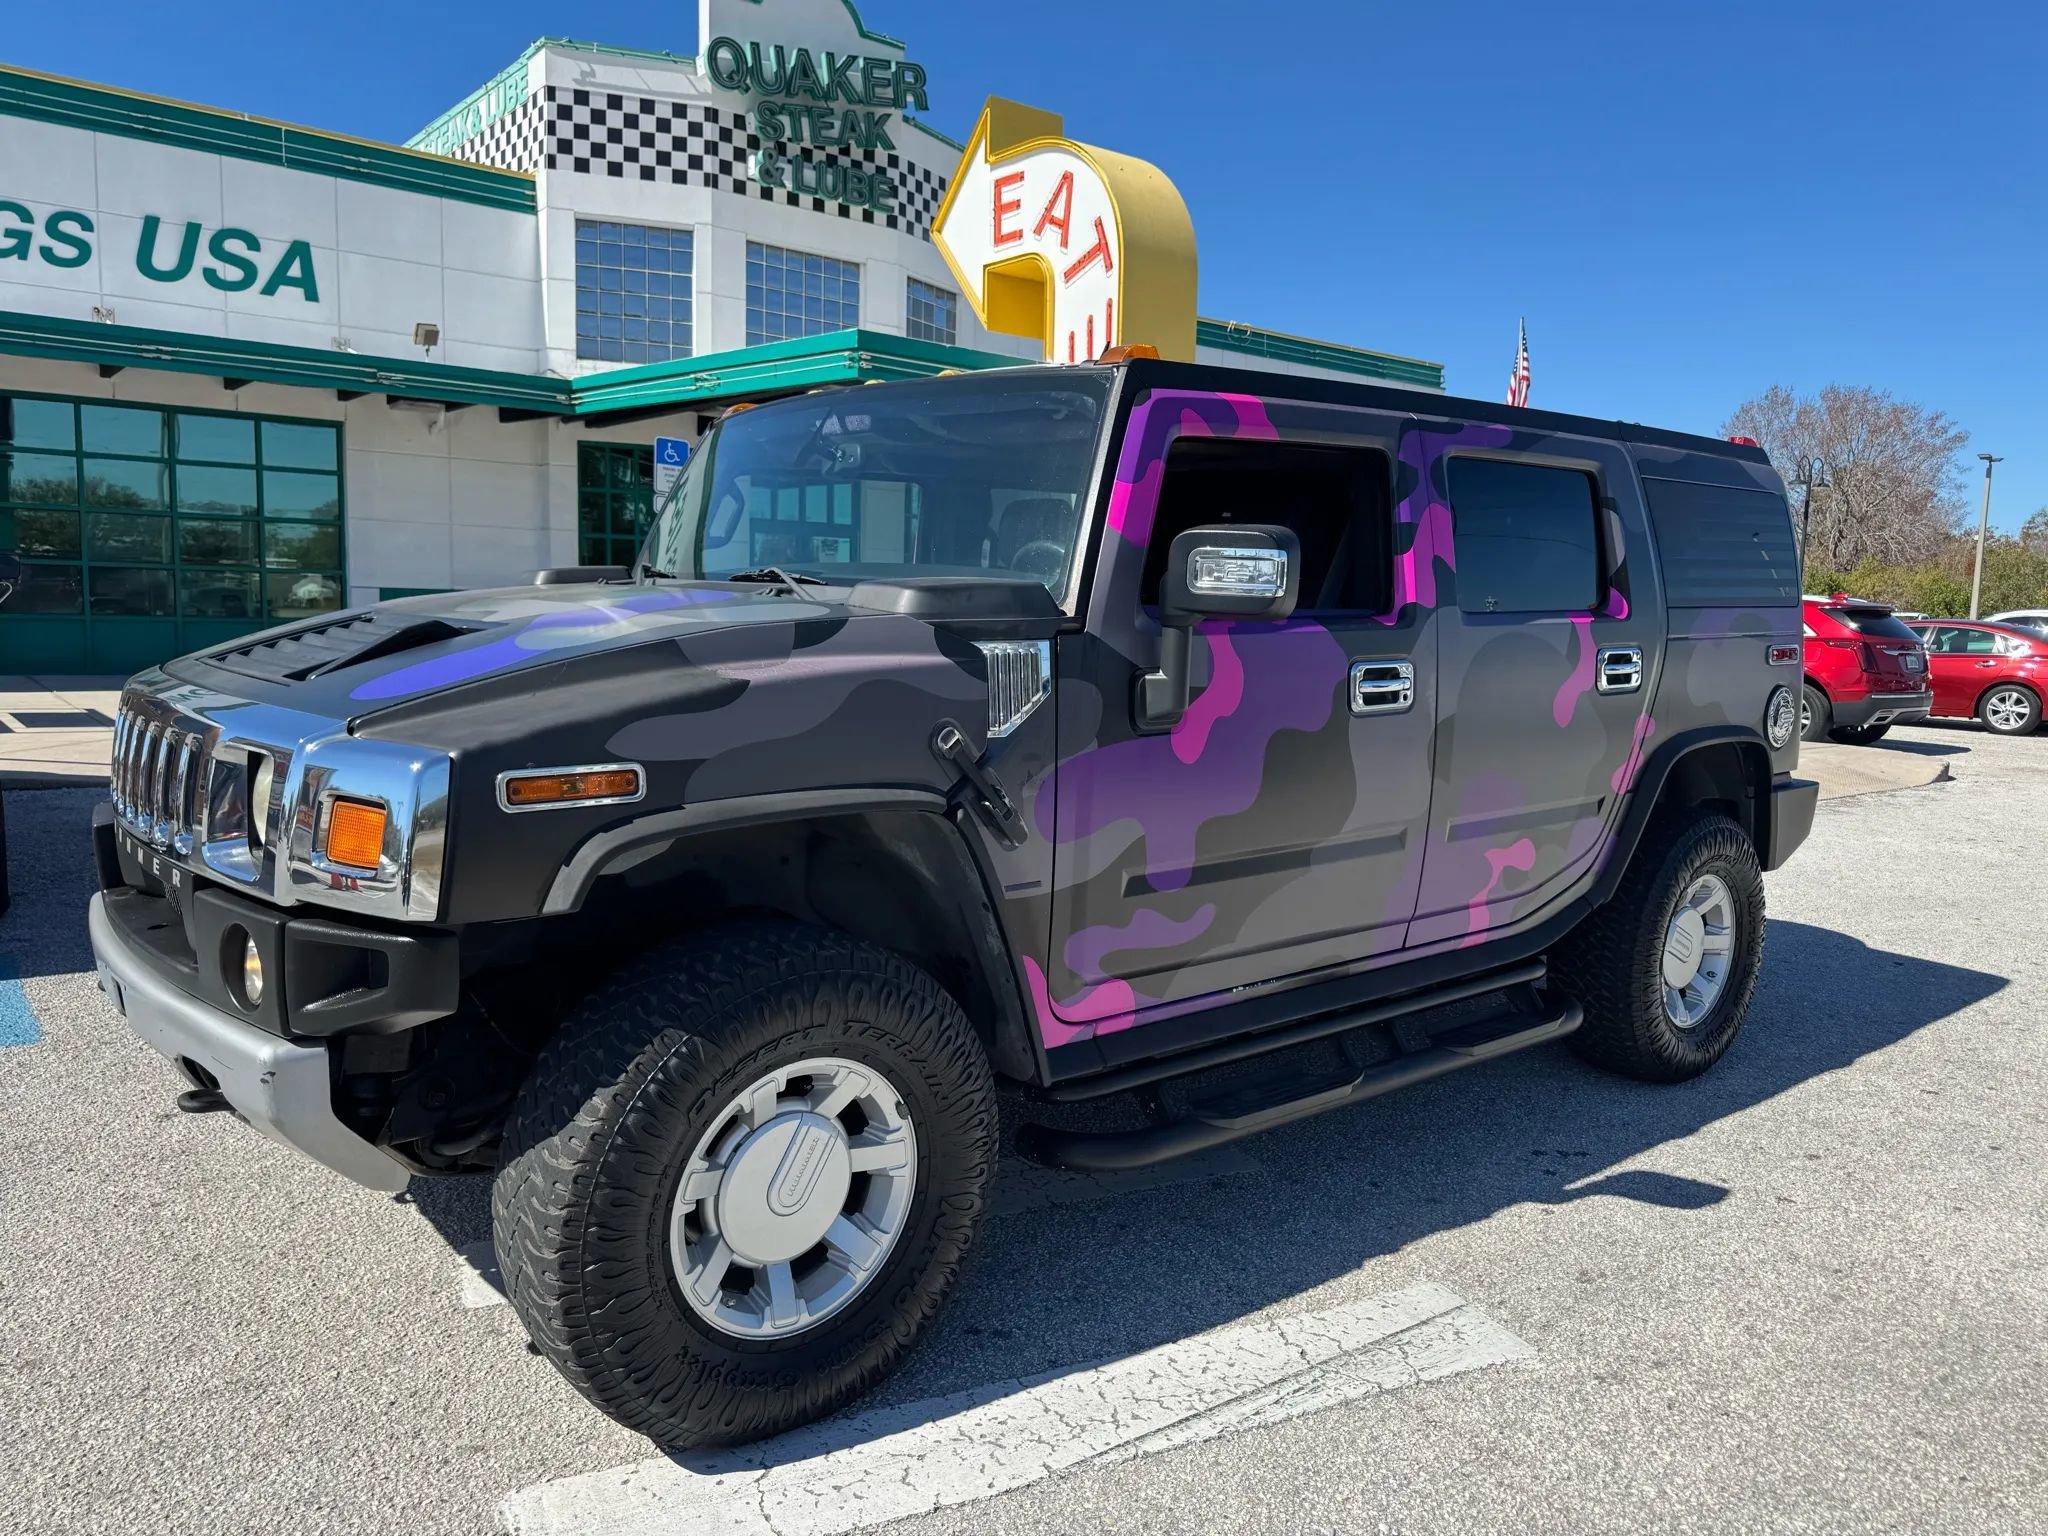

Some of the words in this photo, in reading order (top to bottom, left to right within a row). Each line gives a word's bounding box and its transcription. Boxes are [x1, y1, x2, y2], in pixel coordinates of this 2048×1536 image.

[486, 67, 528, 128] LUBE
[705, 36, 929, 112] QUAKER
[756, 100, 896, 150] STEAK
[756, 147, 786, 188] &
[792, 154, 895, 214] LUBE
[136, 214, 320, 303] USA
[993, 170, 1114, 285] EAT
[685, 1024, 825, 1127] DESERT
